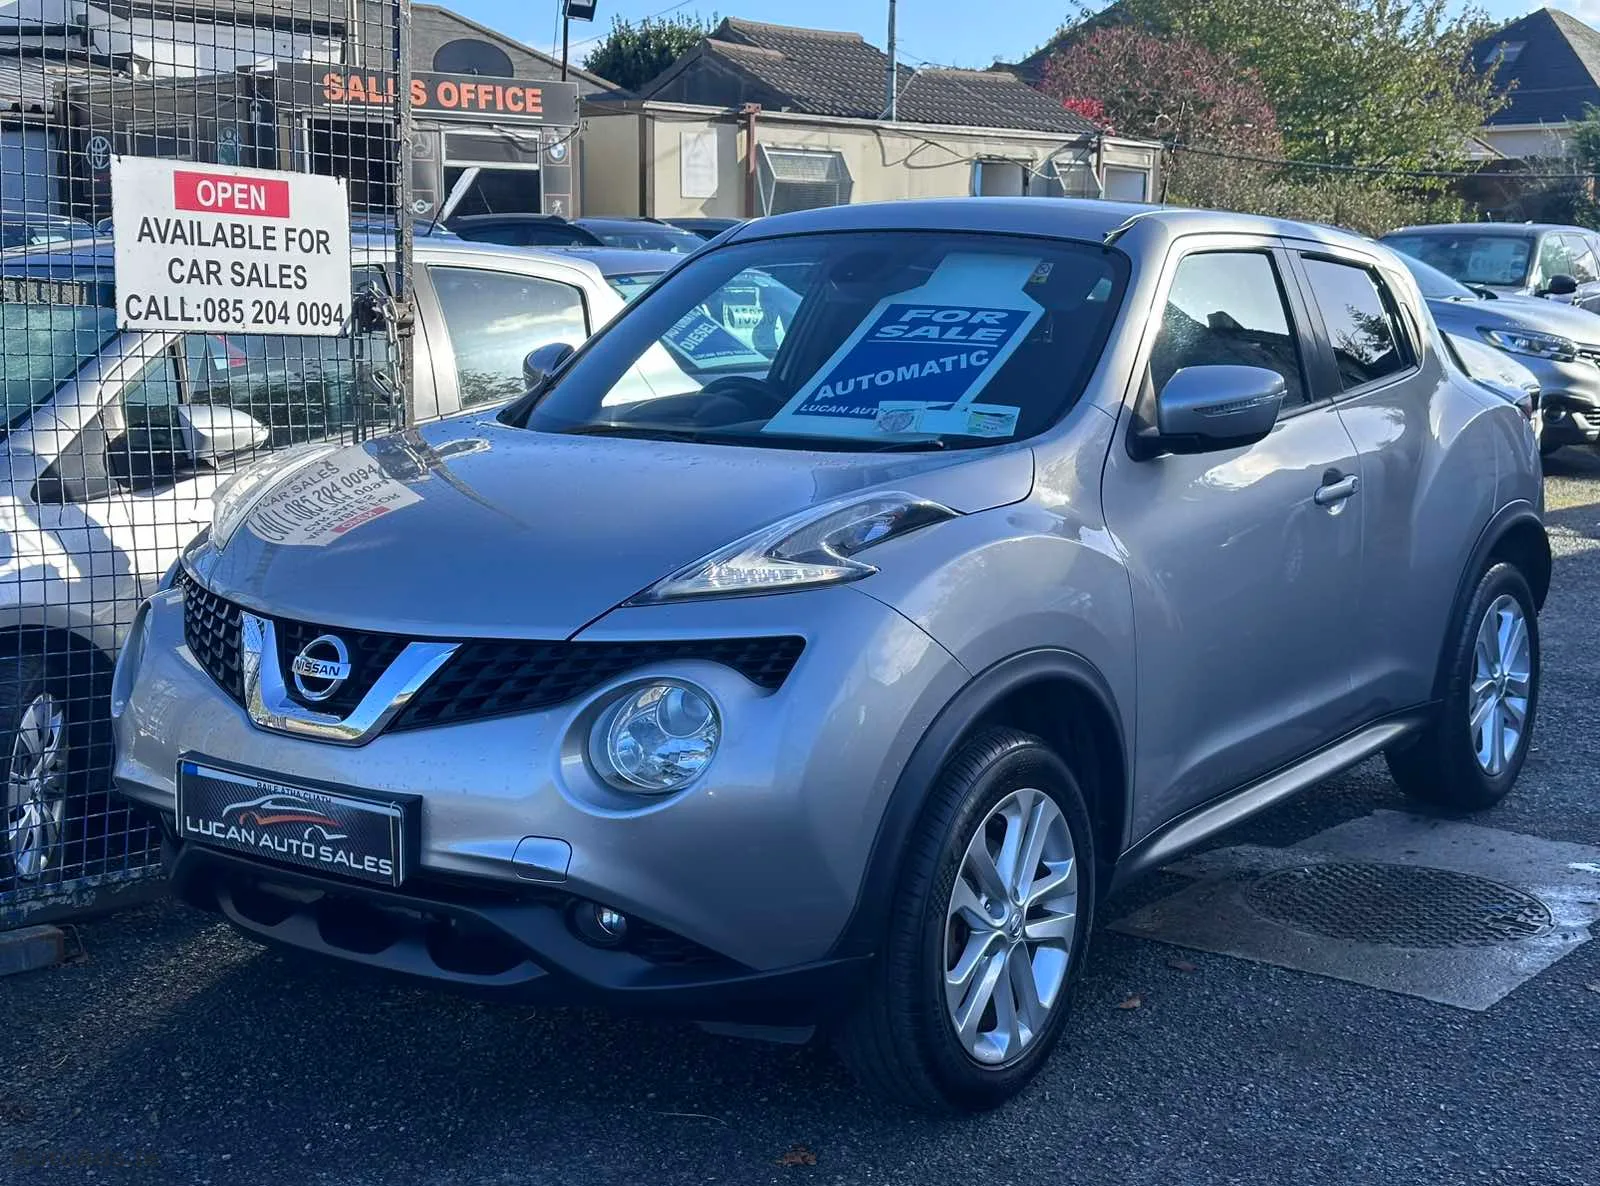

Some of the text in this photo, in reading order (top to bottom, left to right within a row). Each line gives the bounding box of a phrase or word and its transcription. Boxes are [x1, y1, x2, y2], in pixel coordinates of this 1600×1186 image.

[436, 80, 543, 113] OFFICE
[196, 180, 266, 210] OPEN
[137, 217, 331, 254] AVAILABLE FOR
[167, 257, 308, 289] CAR SALES
[125, 294, 344, 326] CALL:085 204 0094
[899, 309, 1008, 325] FOR
[680, 322, 718, 351] DIESEL
[875, 325, 1006, 342] SALE
[814, 350, 990, 402] AUTOMATIC
[800, 404, 881, 416] LUCAN AUT
[294, 659, 341, 676] NISSAN
[186, 815, 393, 875] LUCAN AUTO SALES
